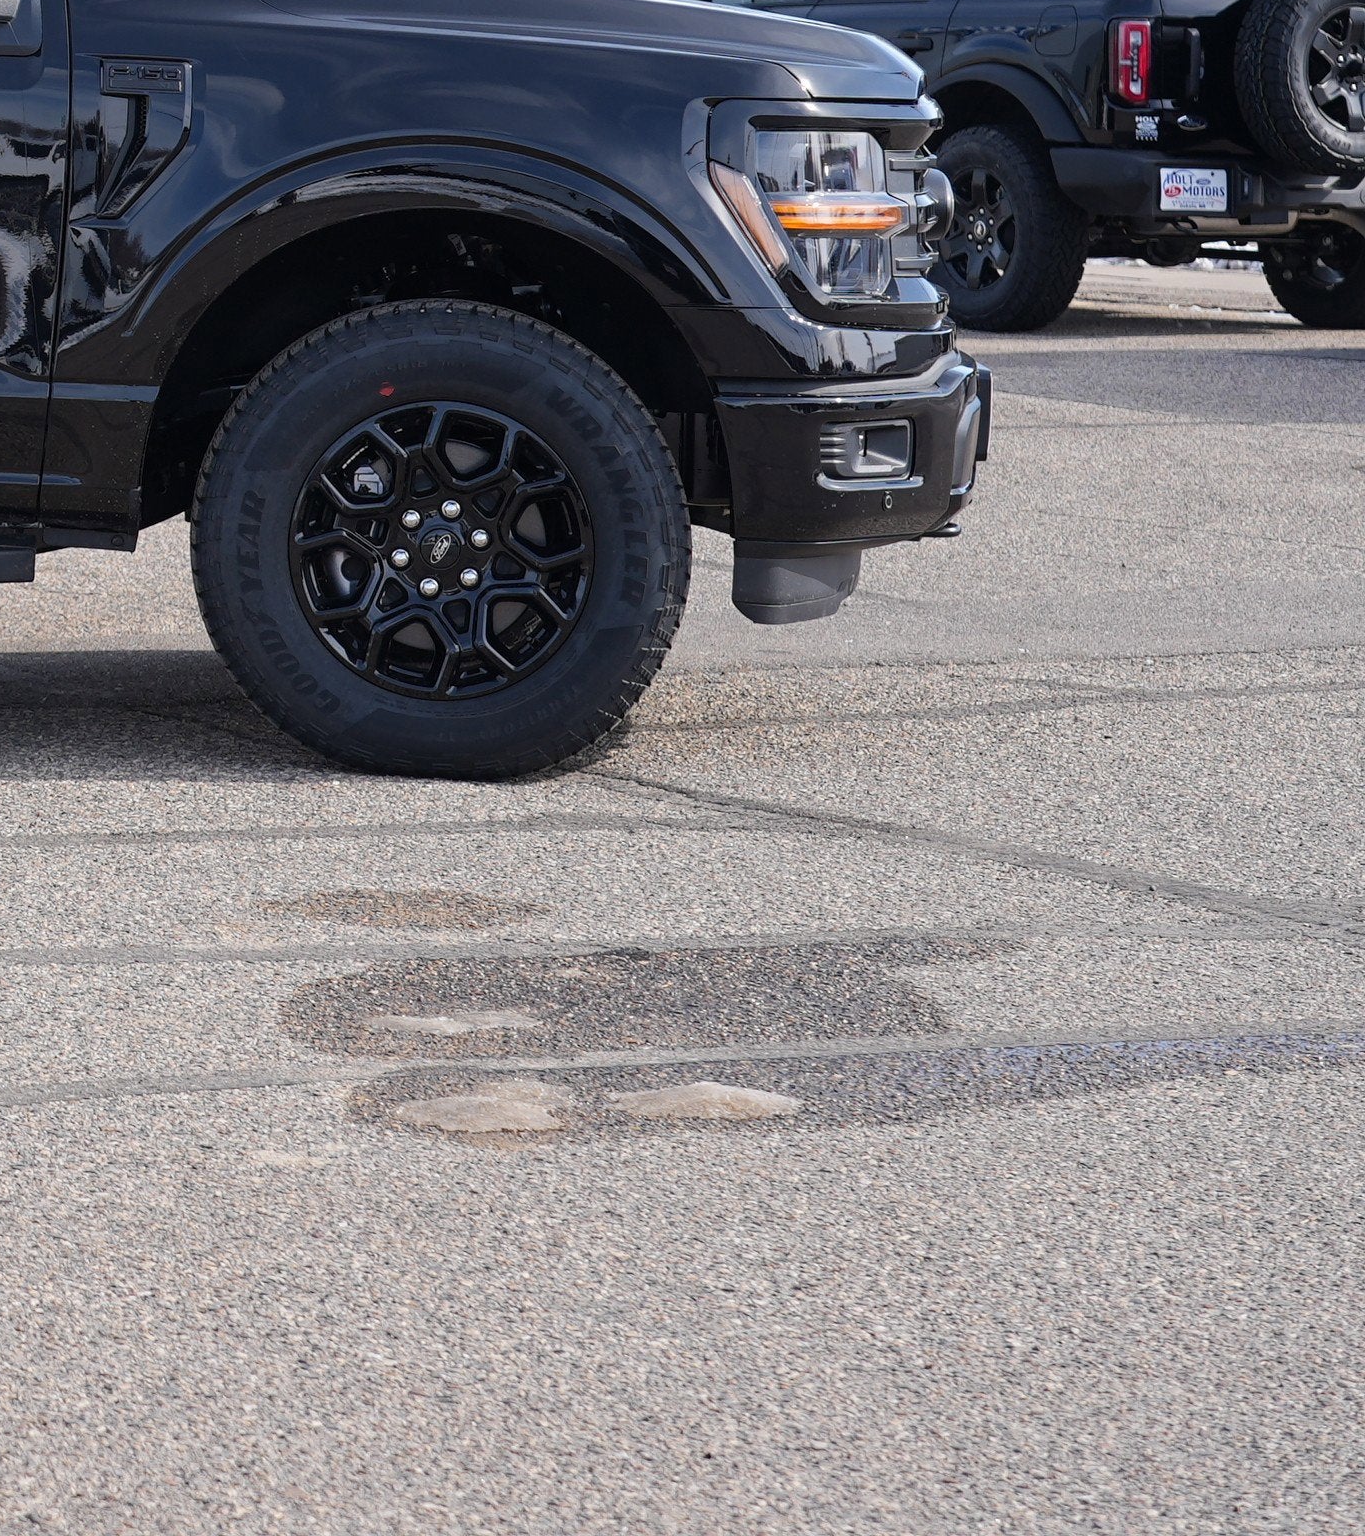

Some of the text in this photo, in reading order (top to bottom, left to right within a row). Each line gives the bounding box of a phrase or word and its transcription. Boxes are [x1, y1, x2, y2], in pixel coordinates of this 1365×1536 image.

[1135, 115, 1160, 124] HOLT
[1166, 173, 1194, 185] HOLT
[1183, 186, 1226, 197] MOTORS
[544, 386, 650, 610] WRANGLER
[235, 488, 343, 716] GOODYEAR
